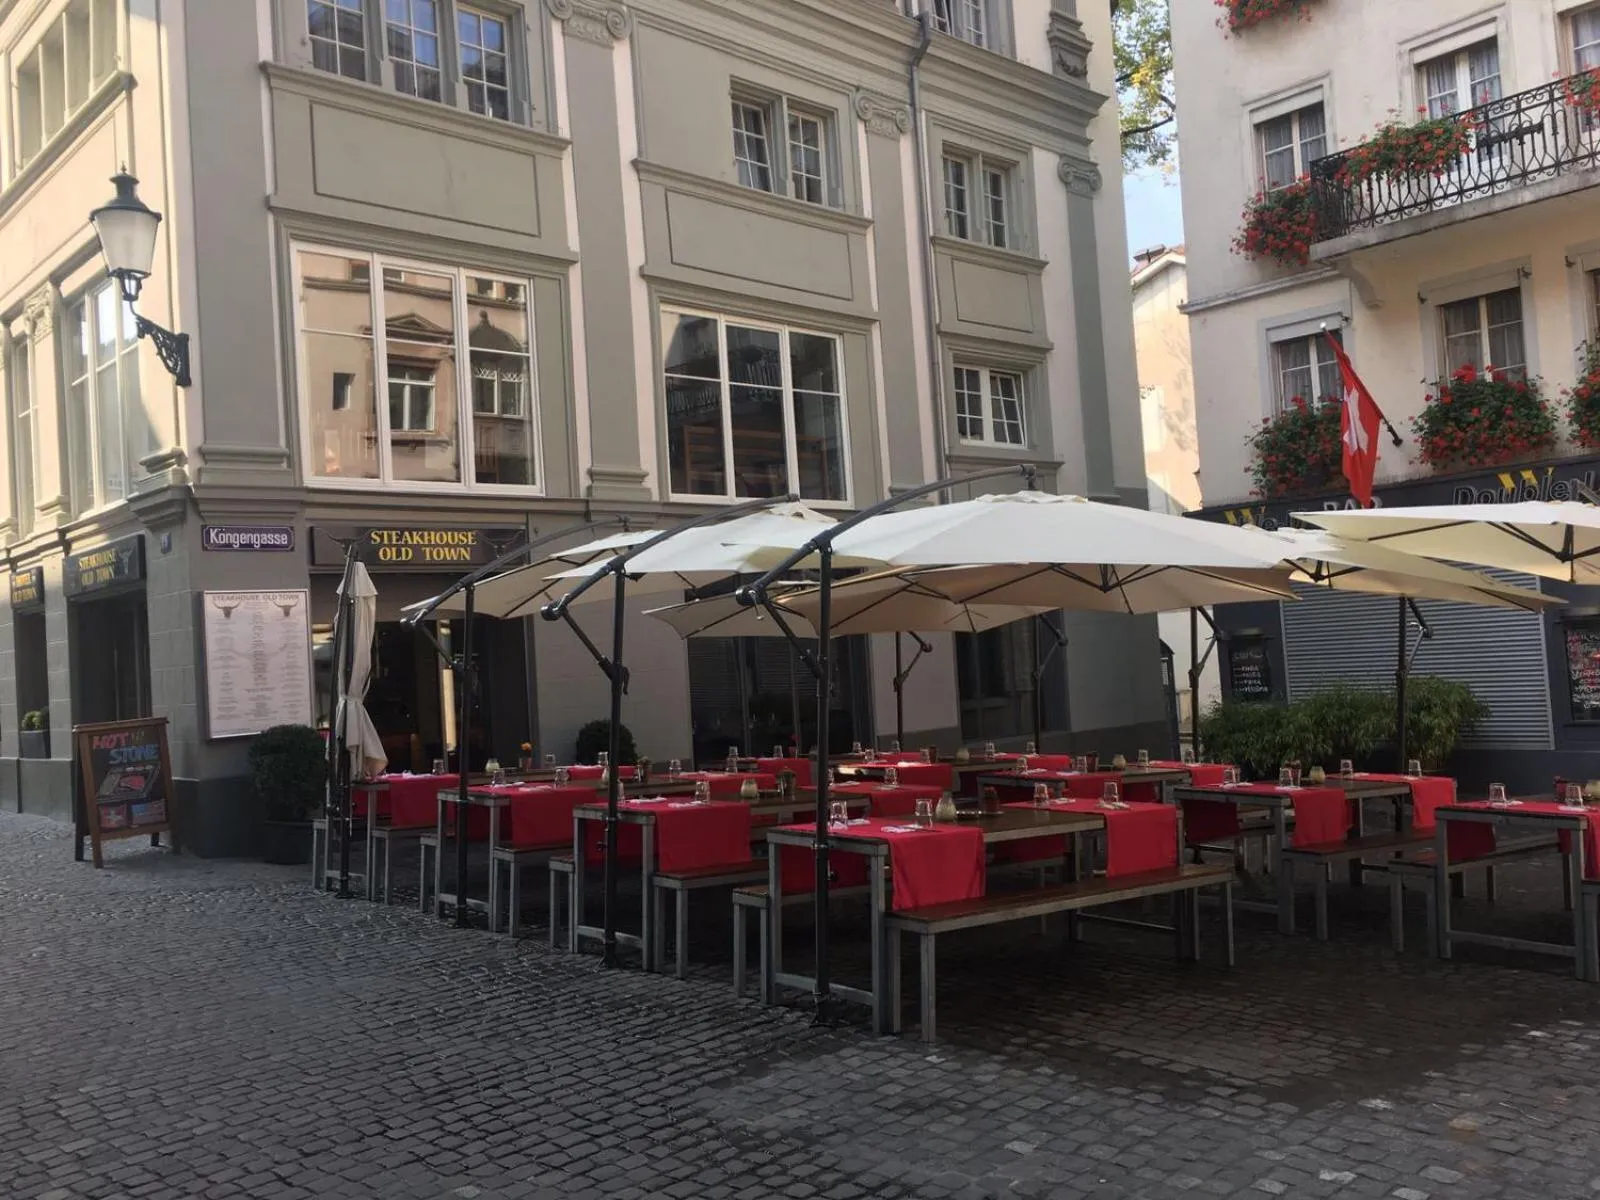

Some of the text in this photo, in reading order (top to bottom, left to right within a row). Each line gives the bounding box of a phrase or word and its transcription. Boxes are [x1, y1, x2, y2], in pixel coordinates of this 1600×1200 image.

[209, 528, 288, 548] Köngengasse
[370, 530, 477, 545] STEAKHOUSE
[378, 546, 471, 561] OLD TOWN
